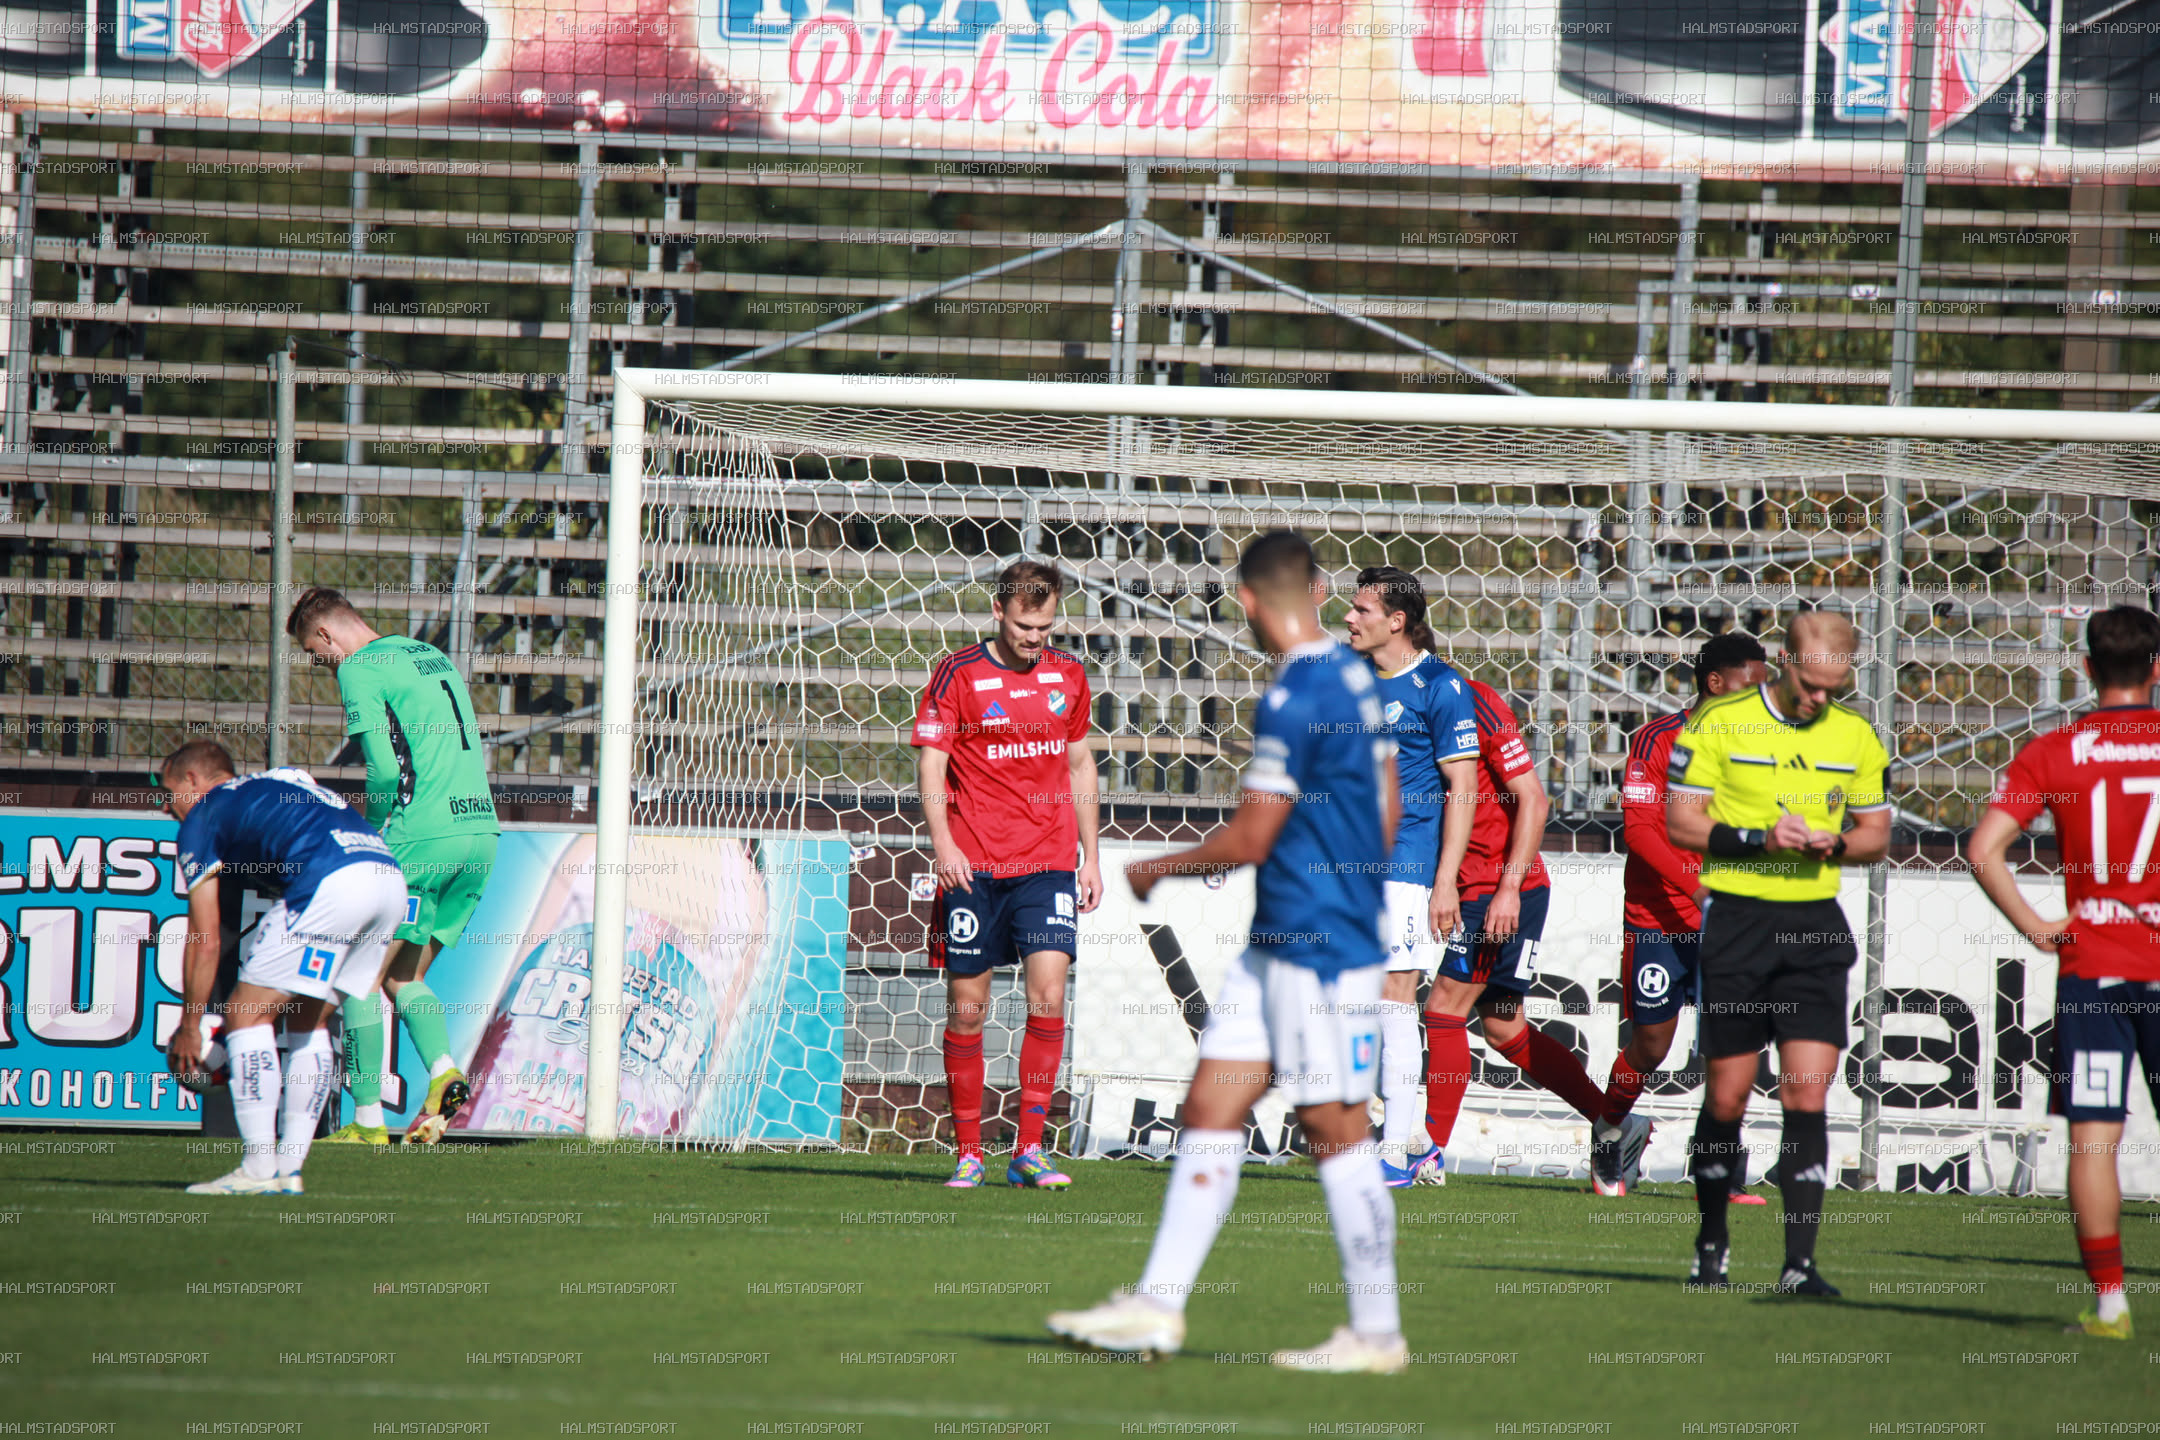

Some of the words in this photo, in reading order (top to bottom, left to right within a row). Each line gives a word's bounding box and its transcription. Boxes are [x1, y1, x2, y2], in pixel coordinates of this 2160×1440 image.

[783, 15, 1016, 123] Black
[1041, 22, 1220, 131] Cola
[440, 680, 471, 751] 1
[1622, 785, 1653, 795] UNIBET
[2090, 777, 2160, 885] 17
